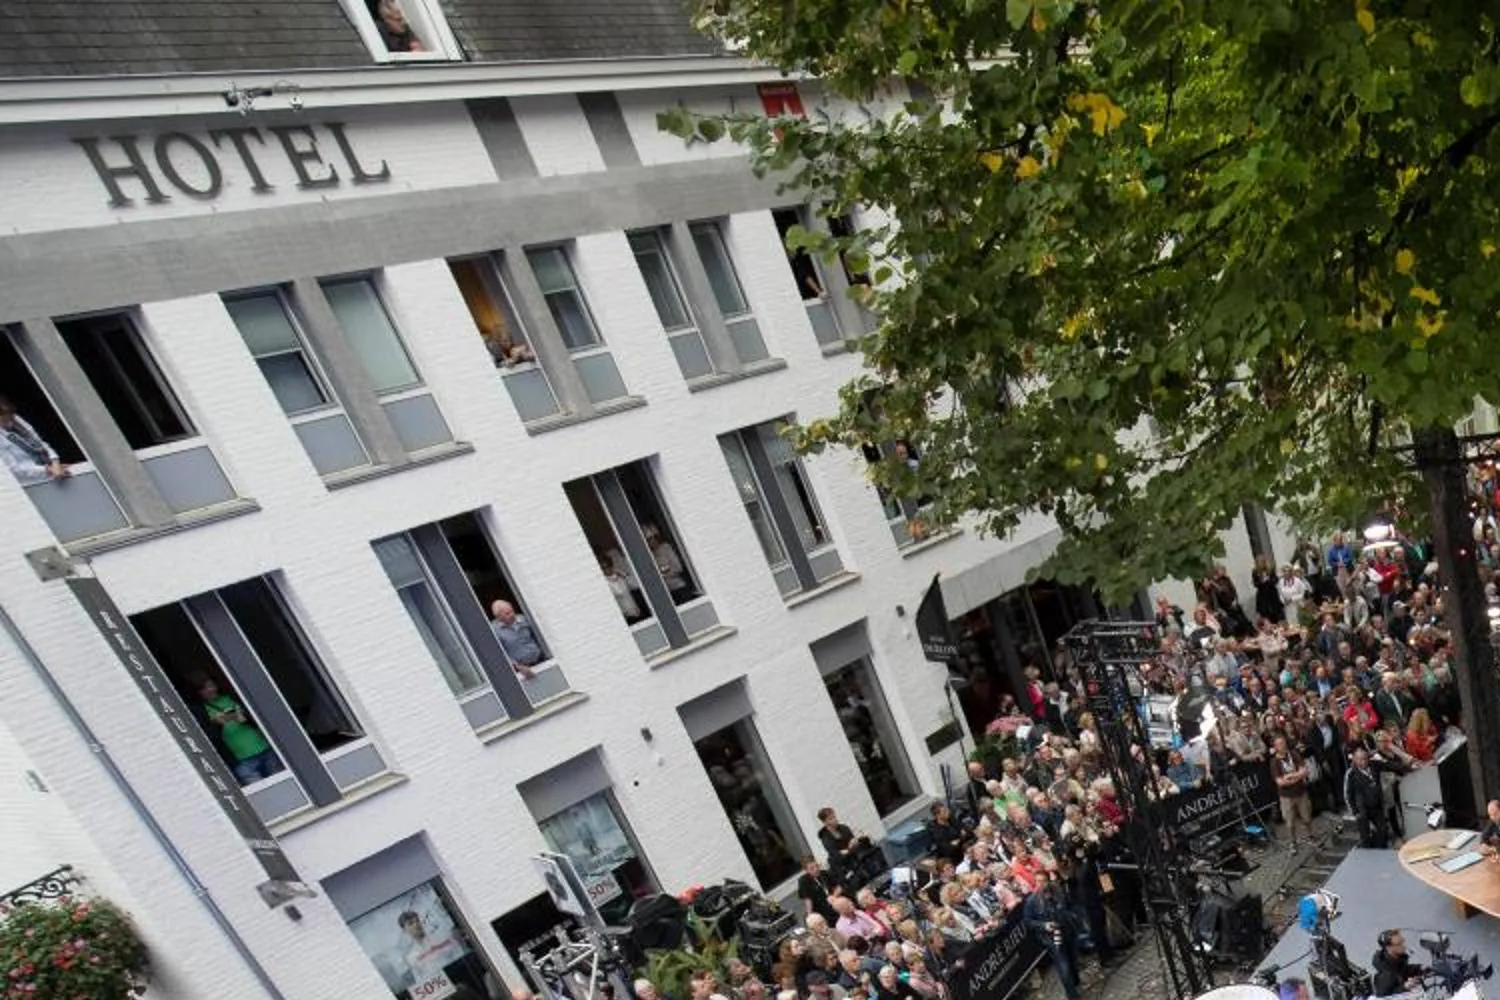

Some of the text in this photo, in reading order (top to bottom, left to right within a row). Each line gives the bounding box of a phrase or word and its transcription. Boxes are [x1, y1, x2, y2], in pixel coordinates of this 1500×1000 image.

[71, 121, 391, 206] HOTEL
[100, 610, 240, 811] RESTAURANT
[414, 975, 447, 999] 50%
